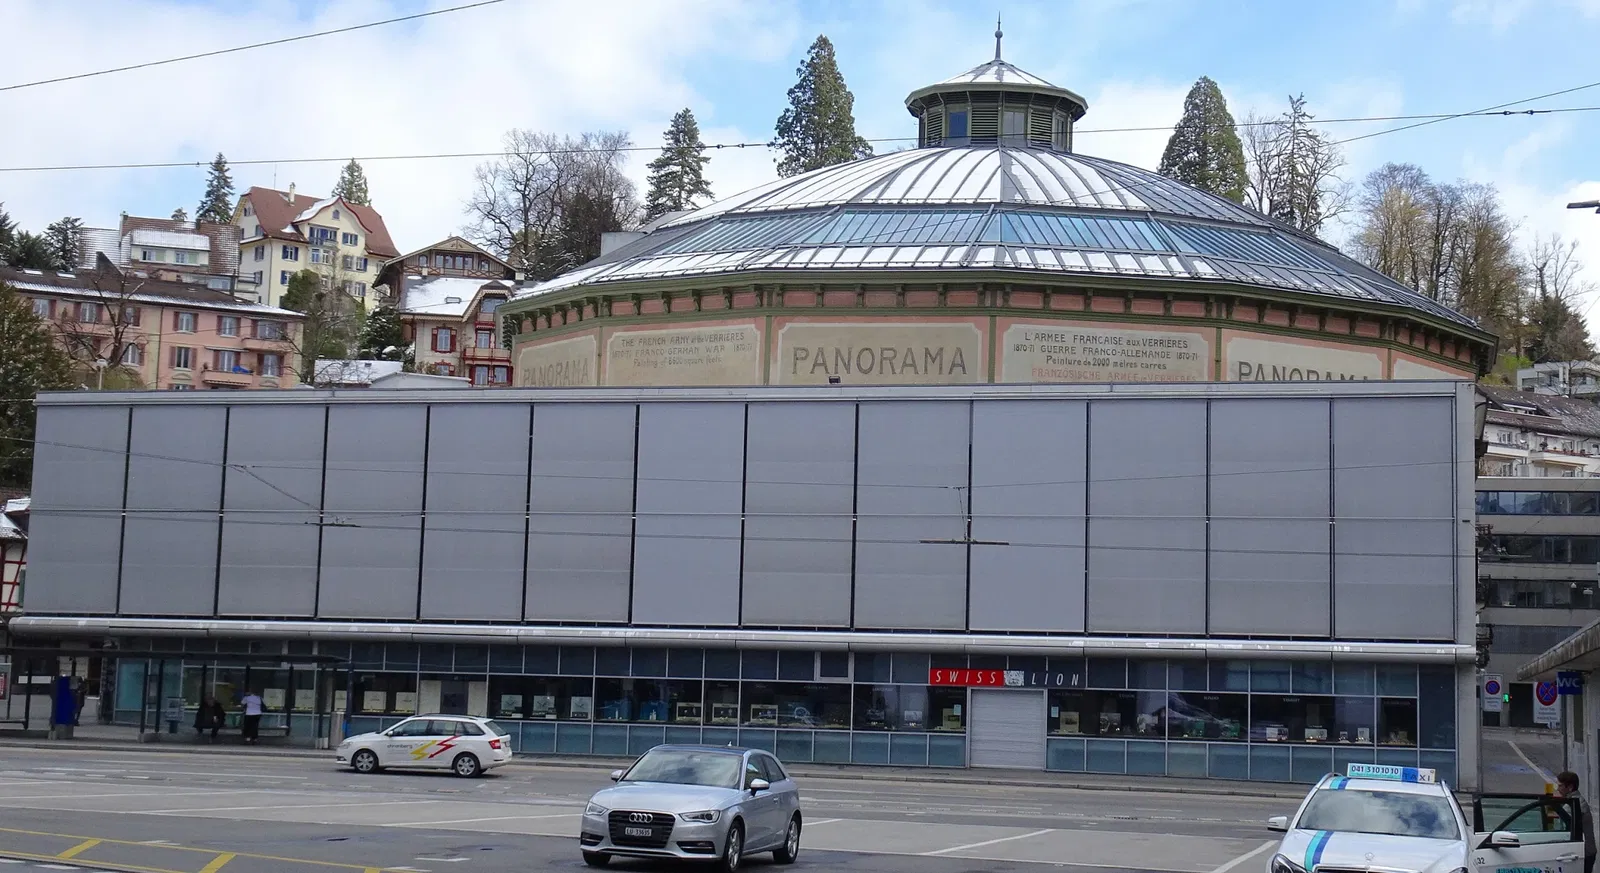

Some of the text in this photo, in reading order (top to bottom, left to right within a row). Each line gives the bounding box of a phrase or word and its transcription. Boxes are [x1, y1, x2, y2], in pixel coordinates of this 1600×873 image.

[621, 338, 635, 348] THE
[638, 337, 666, 347] FRENCH
[670, 335, 690, 345] ARMY
[1126, 339, 1141, 347] aux
[706, 346, 726, 354] WAR
[1040, 344, 1077, 355] GUERRE
[1082, 346, 1171, 359] FRANCO-ALLEMANDE
[792, 346, 967, 375] PANORAMA
[1046, 356, 1082, 367] Peinture
[1092, 357, 1110, 367] 2000
[523, 357, 589, 387] PANORAMA
[935, 669, 1079, 686] SWISS LION
[1558, 677, 1580, 688] WC
[1351, 765, 1364, 773] 041
[1402, 772, 1431, 782] TAXI
